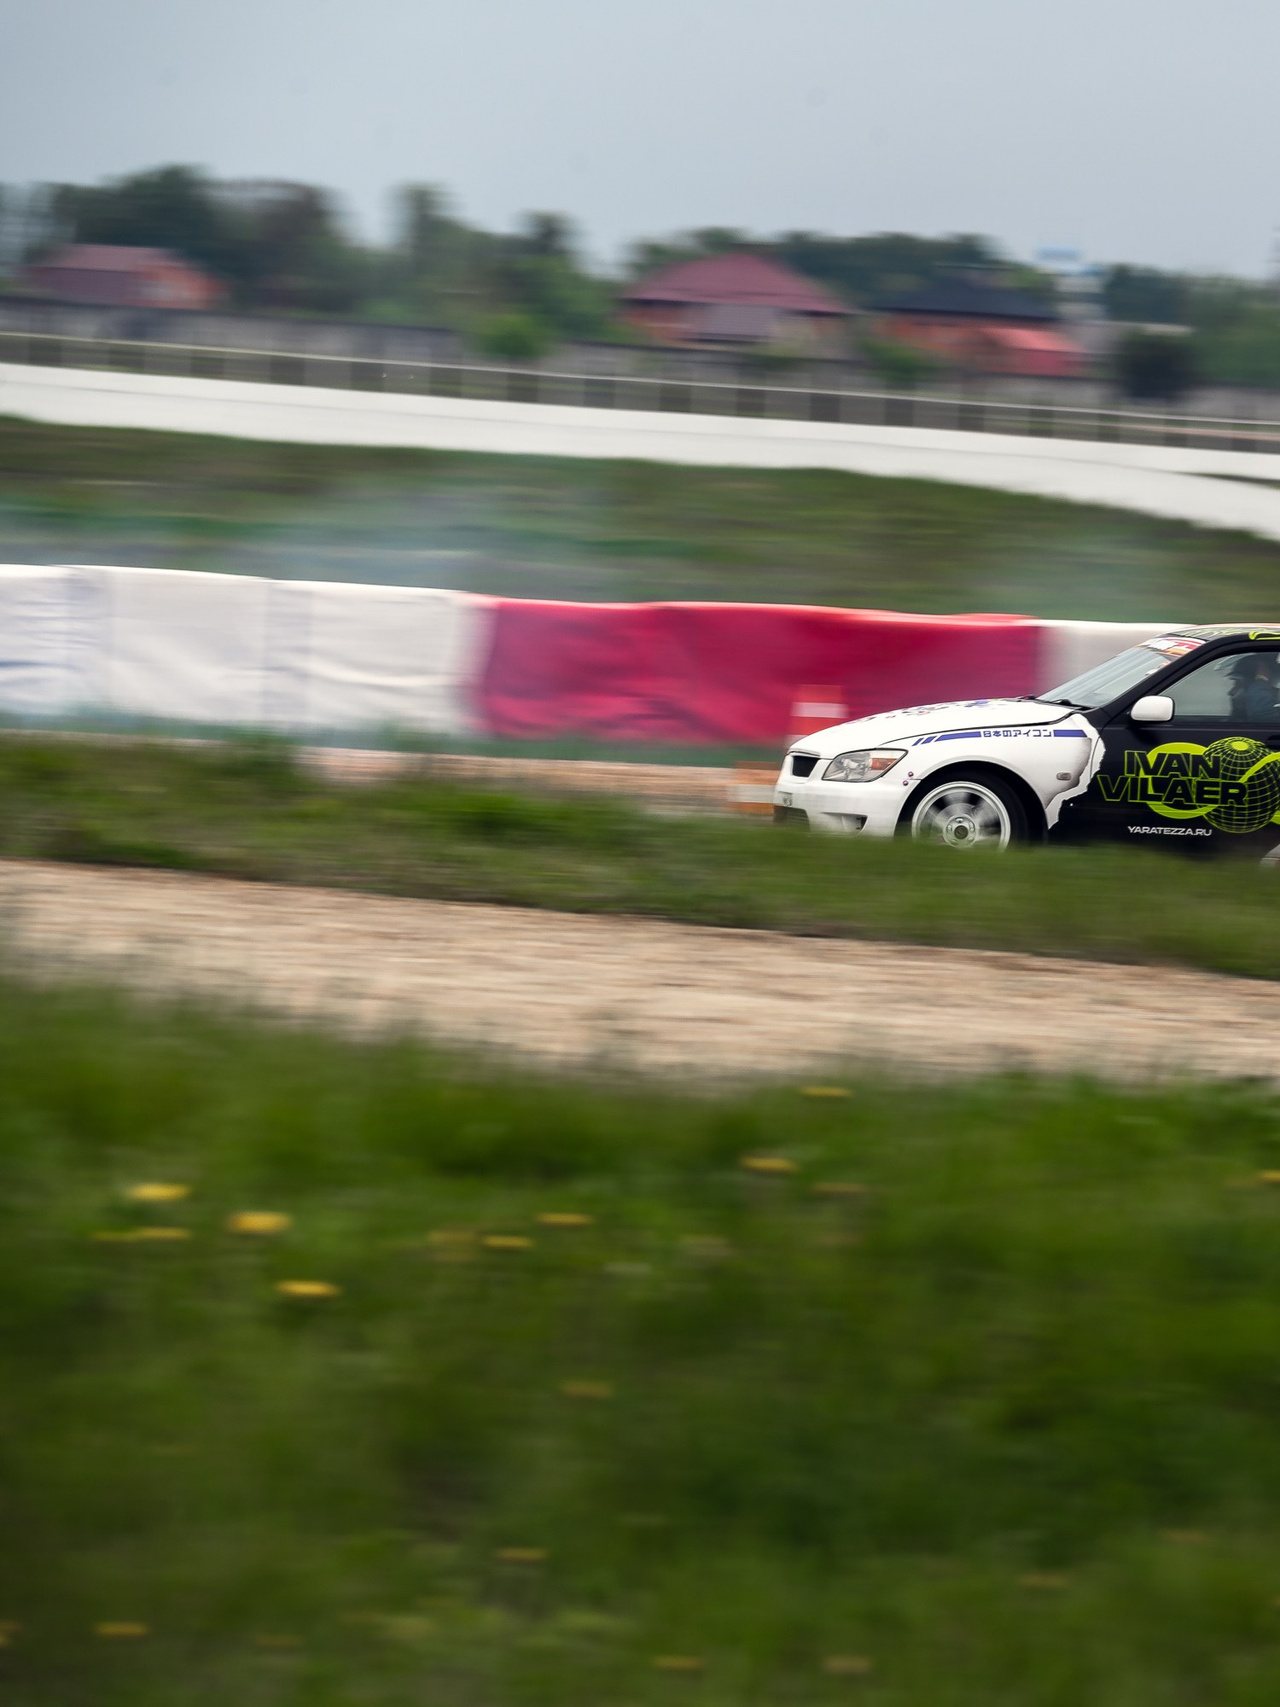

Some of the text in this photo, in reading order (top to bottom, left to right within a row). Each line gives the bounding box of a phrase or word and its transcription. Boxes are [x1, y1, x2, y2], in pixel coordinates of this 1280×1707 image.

[983, 729, 1052, 738] 日本のアイコン
[1125, 750, 1222, 780] IVAN
[1097, 775, 1249, 807] VILAER
[1127, 825, 1213, 837] YARATEZZA.RU
